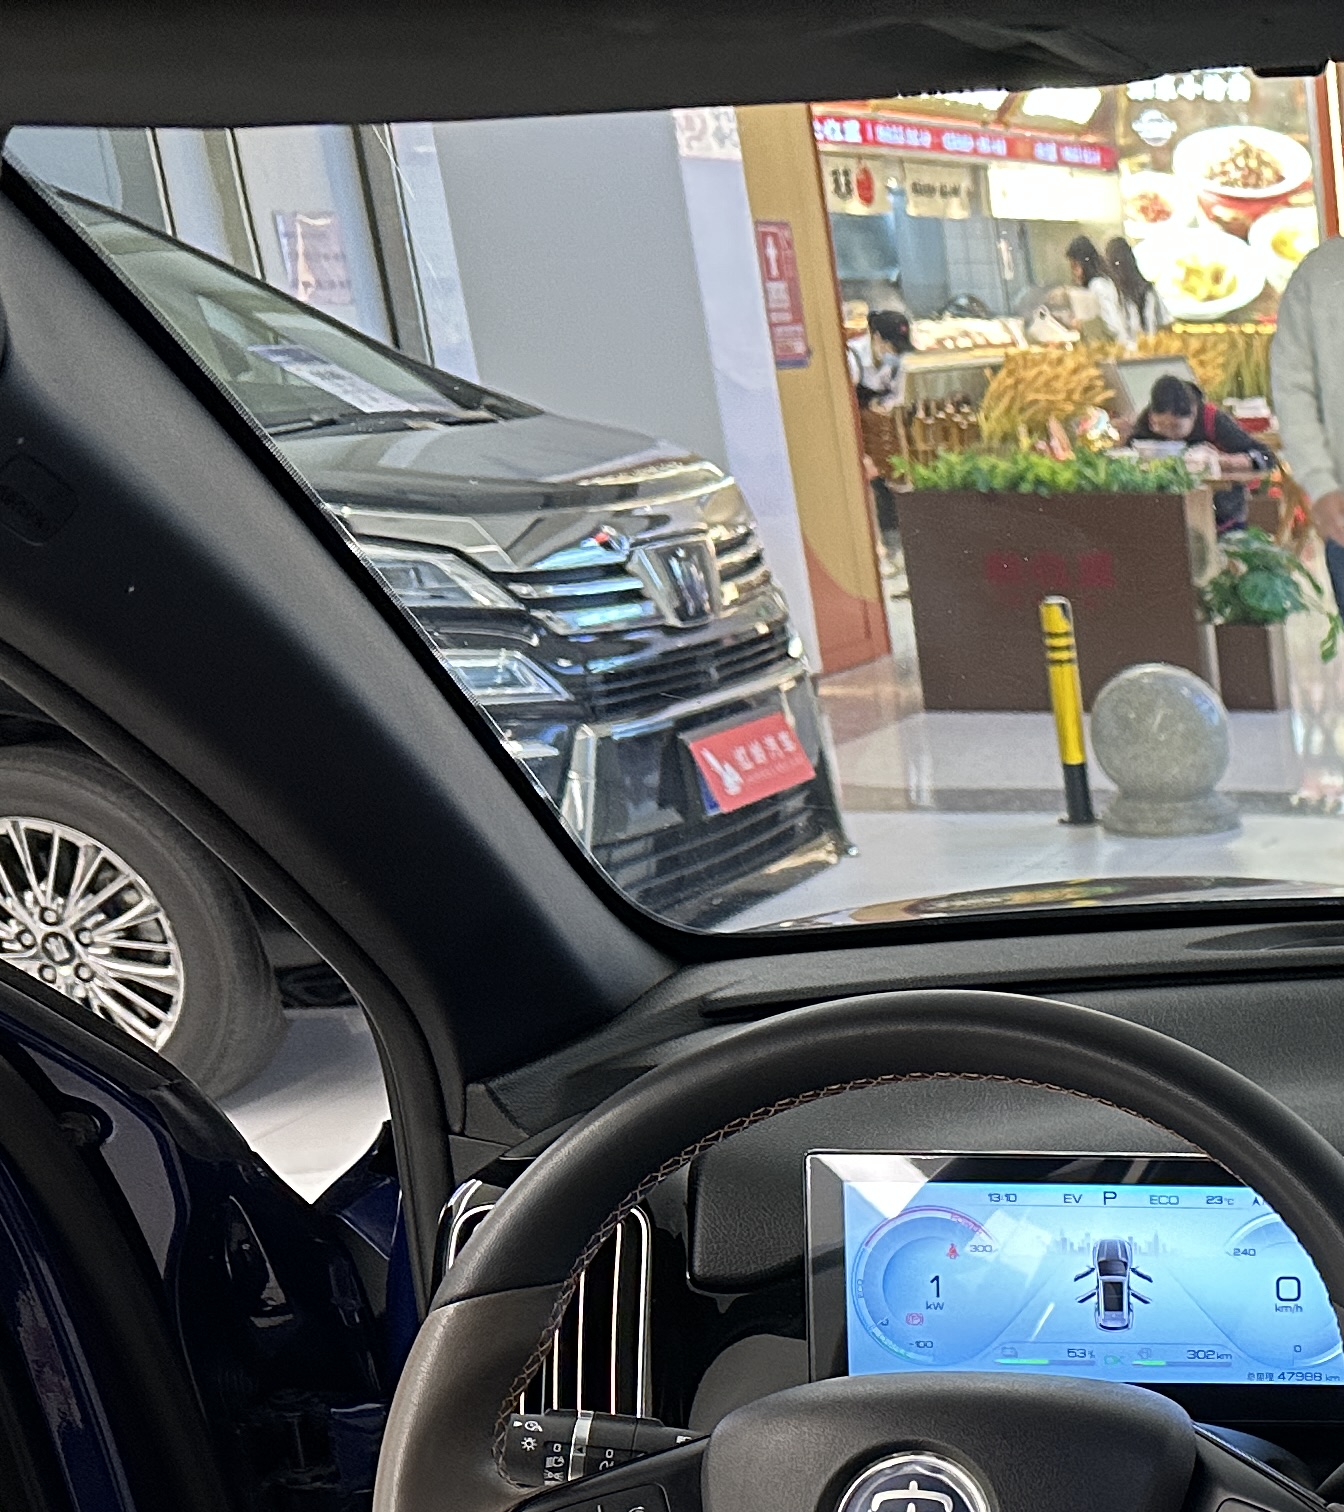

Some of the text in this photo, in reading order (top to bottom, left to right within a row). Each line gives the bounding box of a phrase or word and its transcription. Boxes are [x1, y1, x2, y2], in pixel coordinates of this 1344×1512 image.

[1063, 1193, 1082, 1205] EV
[1103, 1191, 1117, 1206] P
[1150, 1195, 1179, 1205] ECO
[969, 1245, 992, 1253] 300
[1233, 1248, 1256, 1256] 240
[929, 1275, 940, 1298] 1
[1276, 1276, 1301, 1301] 0
[926, 1301, 944, 1310] kW
[1275, 1303, 1303, 1313] km/h
[1325, 1373, 1340, 1382] km
